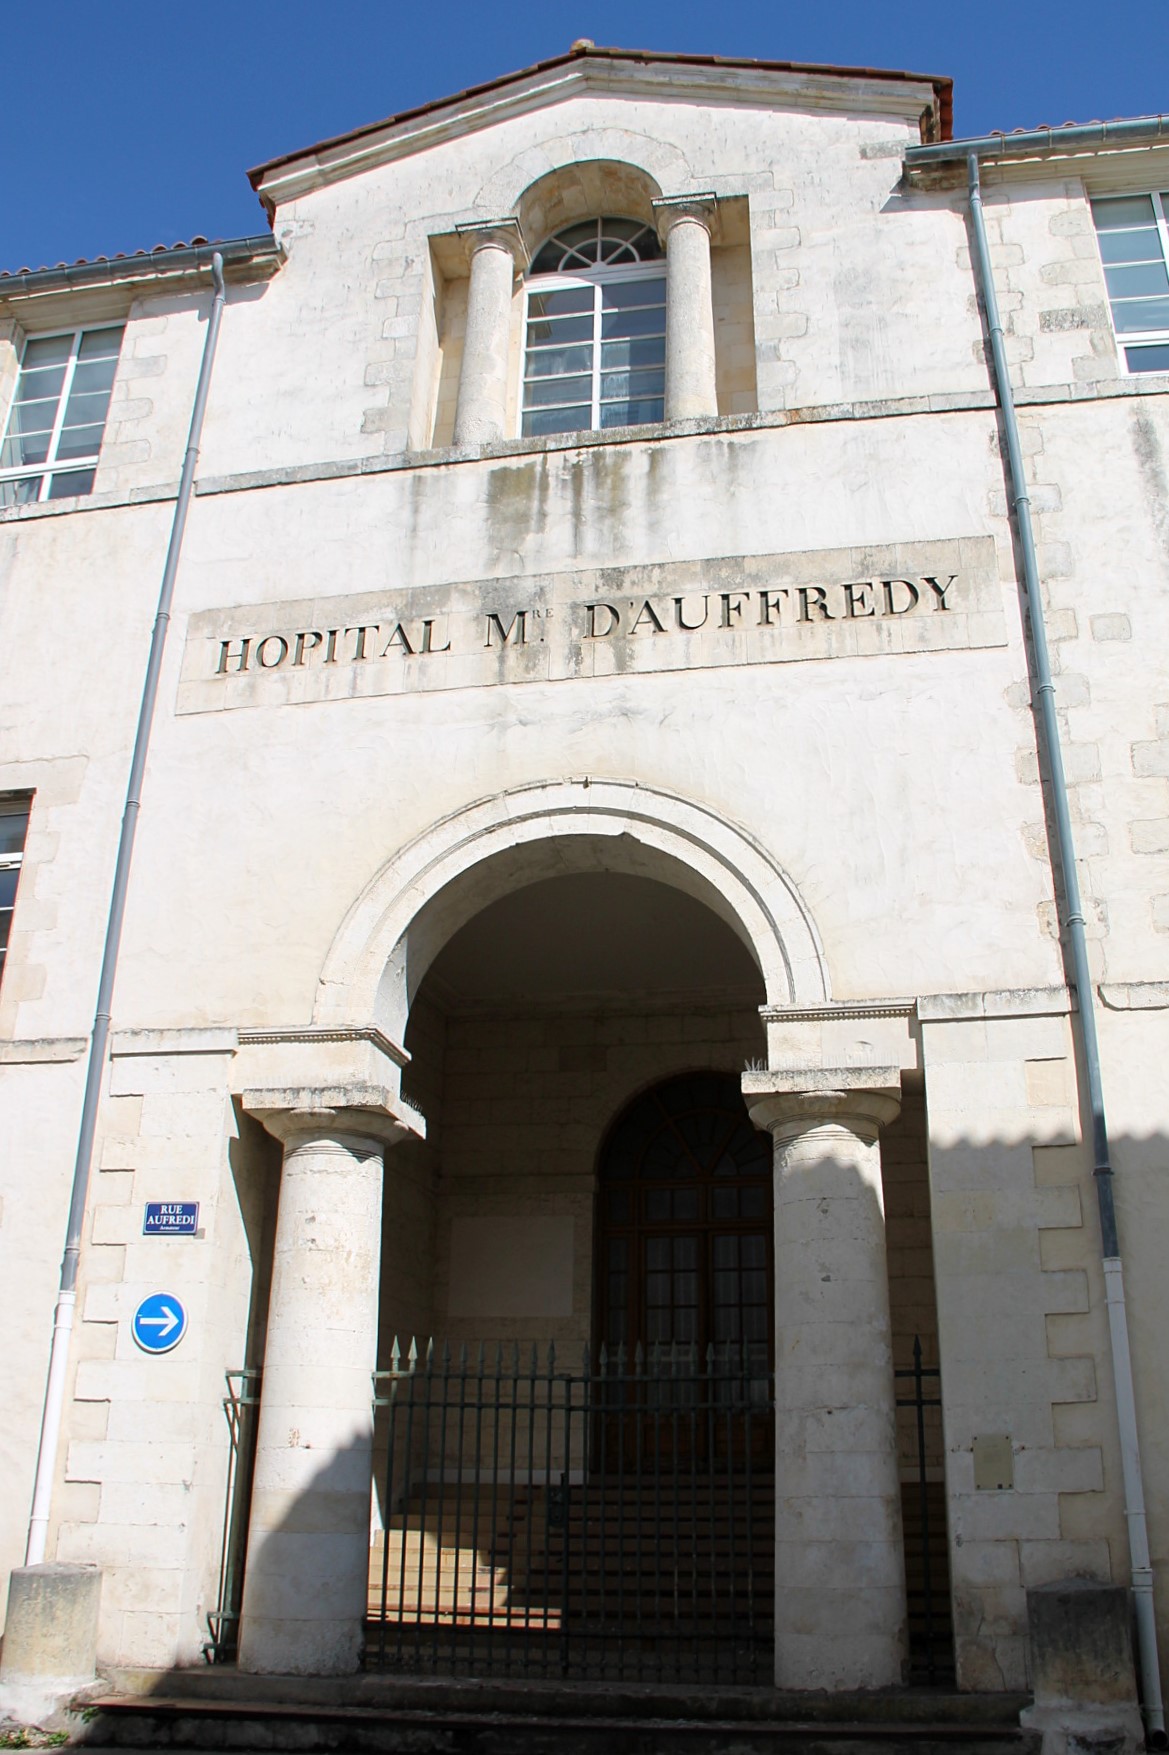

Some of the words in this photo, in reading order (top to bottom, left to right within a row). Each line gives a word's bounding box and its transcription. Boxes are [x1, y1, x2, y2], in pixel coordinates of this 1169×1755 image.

[215, 619, 451, 674] HOPITAL
[582, 574, 959, 640] D'AUFFREDY
[160, 1204, 183, 1215] RUE
[146, 1215, 195, 1225] AUFREDI
